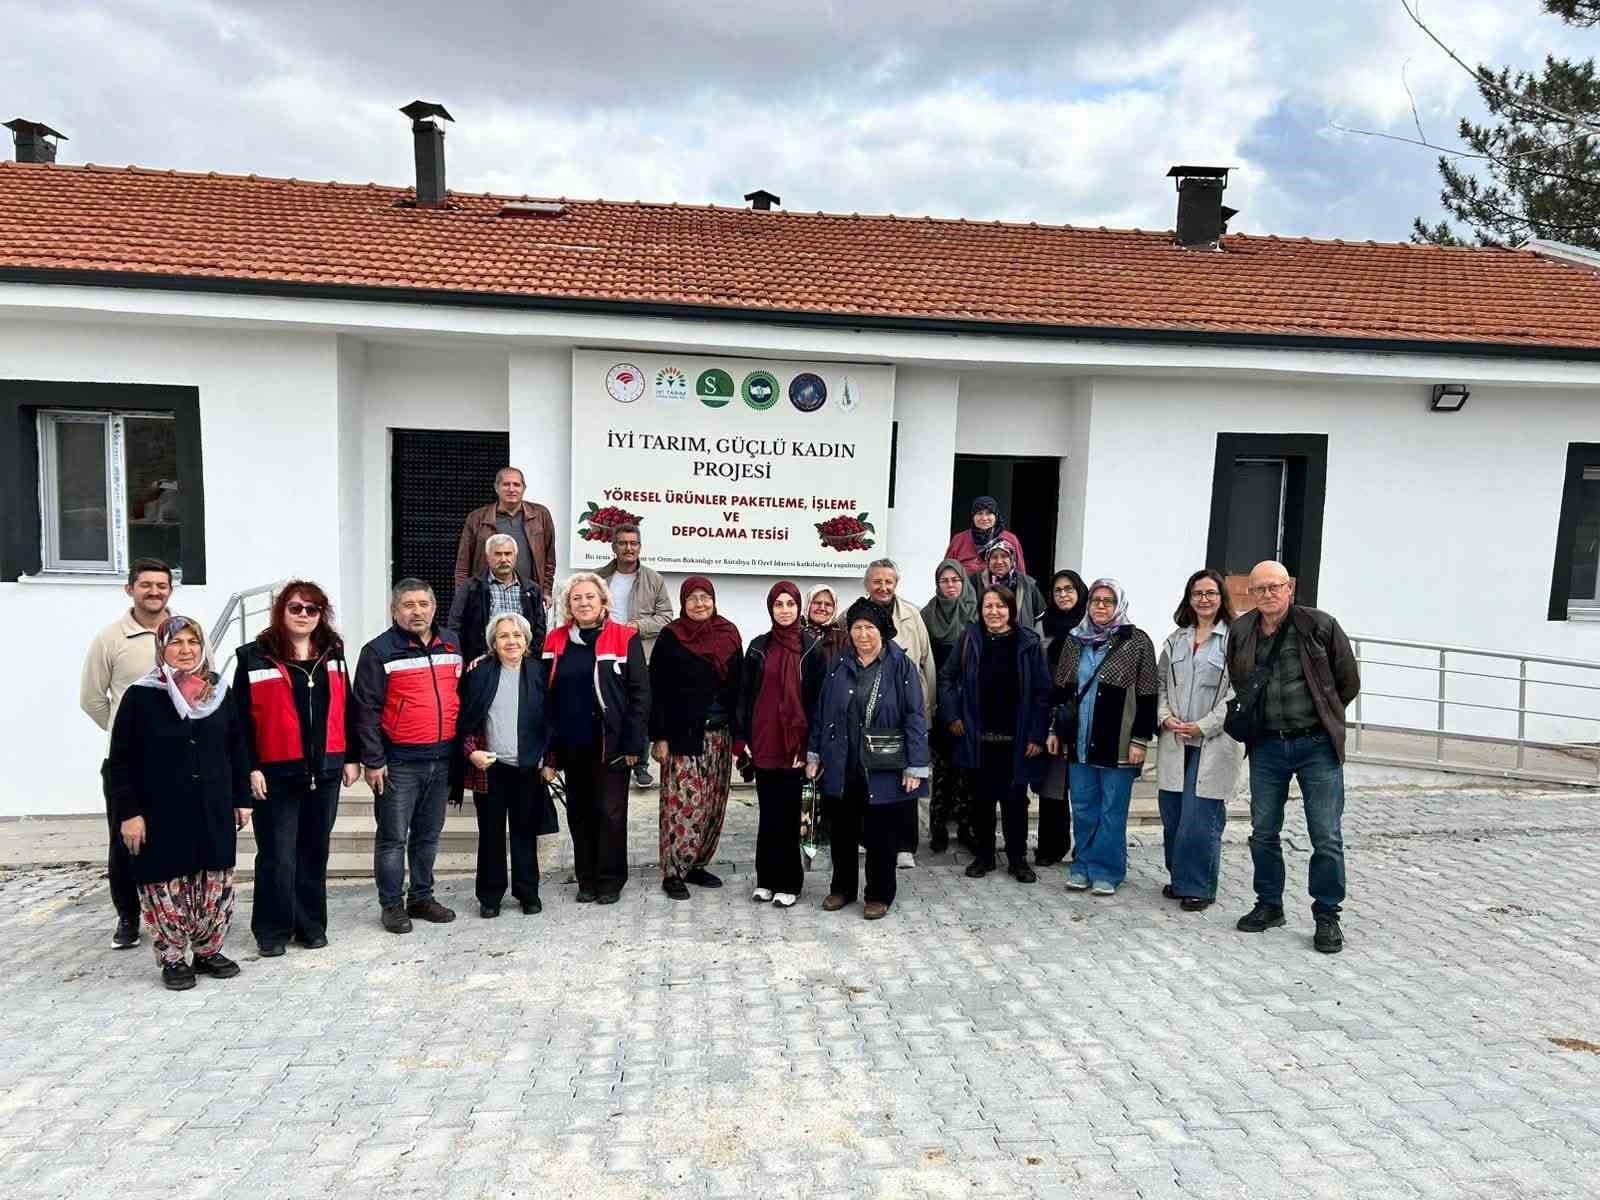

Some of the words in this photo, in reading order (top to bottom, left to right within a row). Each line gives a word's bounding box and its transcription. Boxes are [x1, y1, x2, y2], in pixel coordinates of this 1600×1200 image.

[704, 375, 717, 395] S
[608, 429, 634, 448] İYİ
[639, 433, 711, 455] TARIM,
[716, 435, 786, 458] GÜÇLÜ
[792, 441, 856, 458] KADIN
[693, 461, 771, 482] PROJESİ
[603, 487, 662, 503] YÖRESEL
[665, 490, 727, 506] ÜRÜNLER
[731, 496, 807, 511] PAKETLEME,
[812, 496, 857, 512] İŞLEME
[723, 511, 740, 522] VE
[672, 525, 748, 539] DEPOLAMA
[751, 526, 789, 541] TESİSİ
